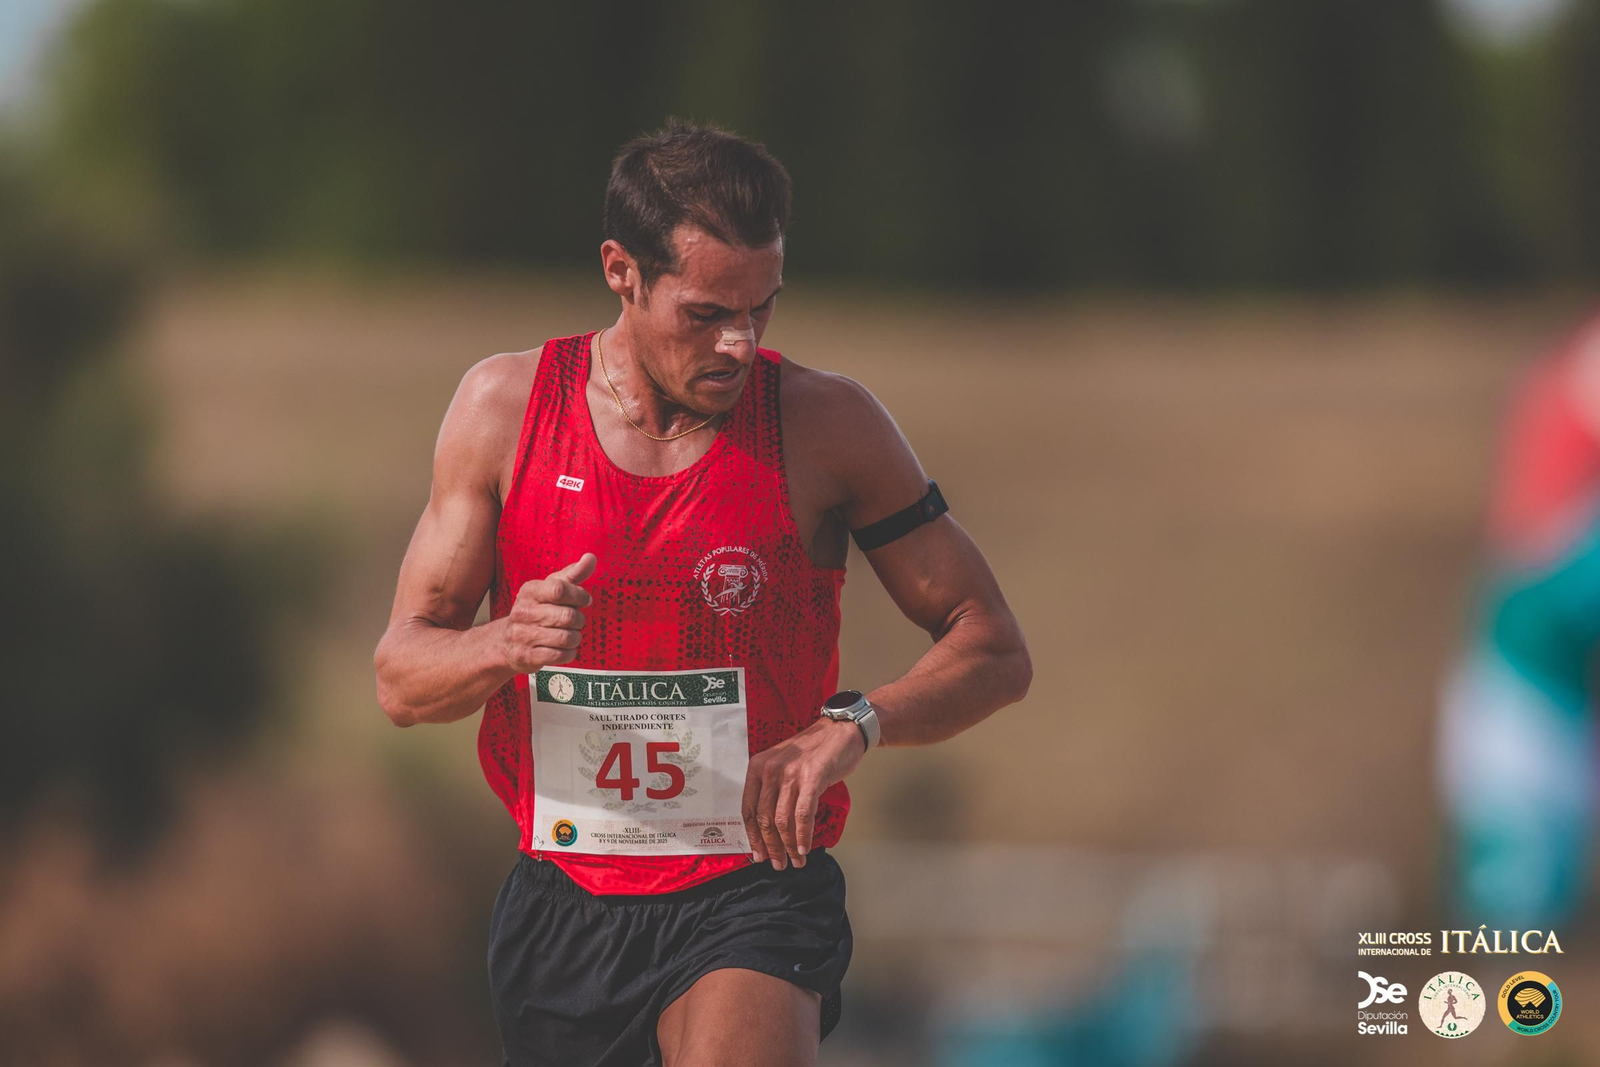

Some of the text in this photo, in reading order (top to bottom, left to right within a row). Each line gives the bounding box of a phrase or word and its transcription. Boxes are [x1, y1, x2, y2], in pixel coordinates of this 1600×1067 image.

[559, 478, 582, 489] 42K
[693, 545, 769, 583] ATLETAS POPULARES DE MÉRIDA
[587, 678, 687, 701] ITÁLICA
[703, 696, 727, 704] Sevilla
[589, 714, 612, 722] SAUL
[650, 713, 686, 721] CORTES
[602, 723, 674, 731] INDEPENDIENTE
[595, 741, 686, 802] 45
